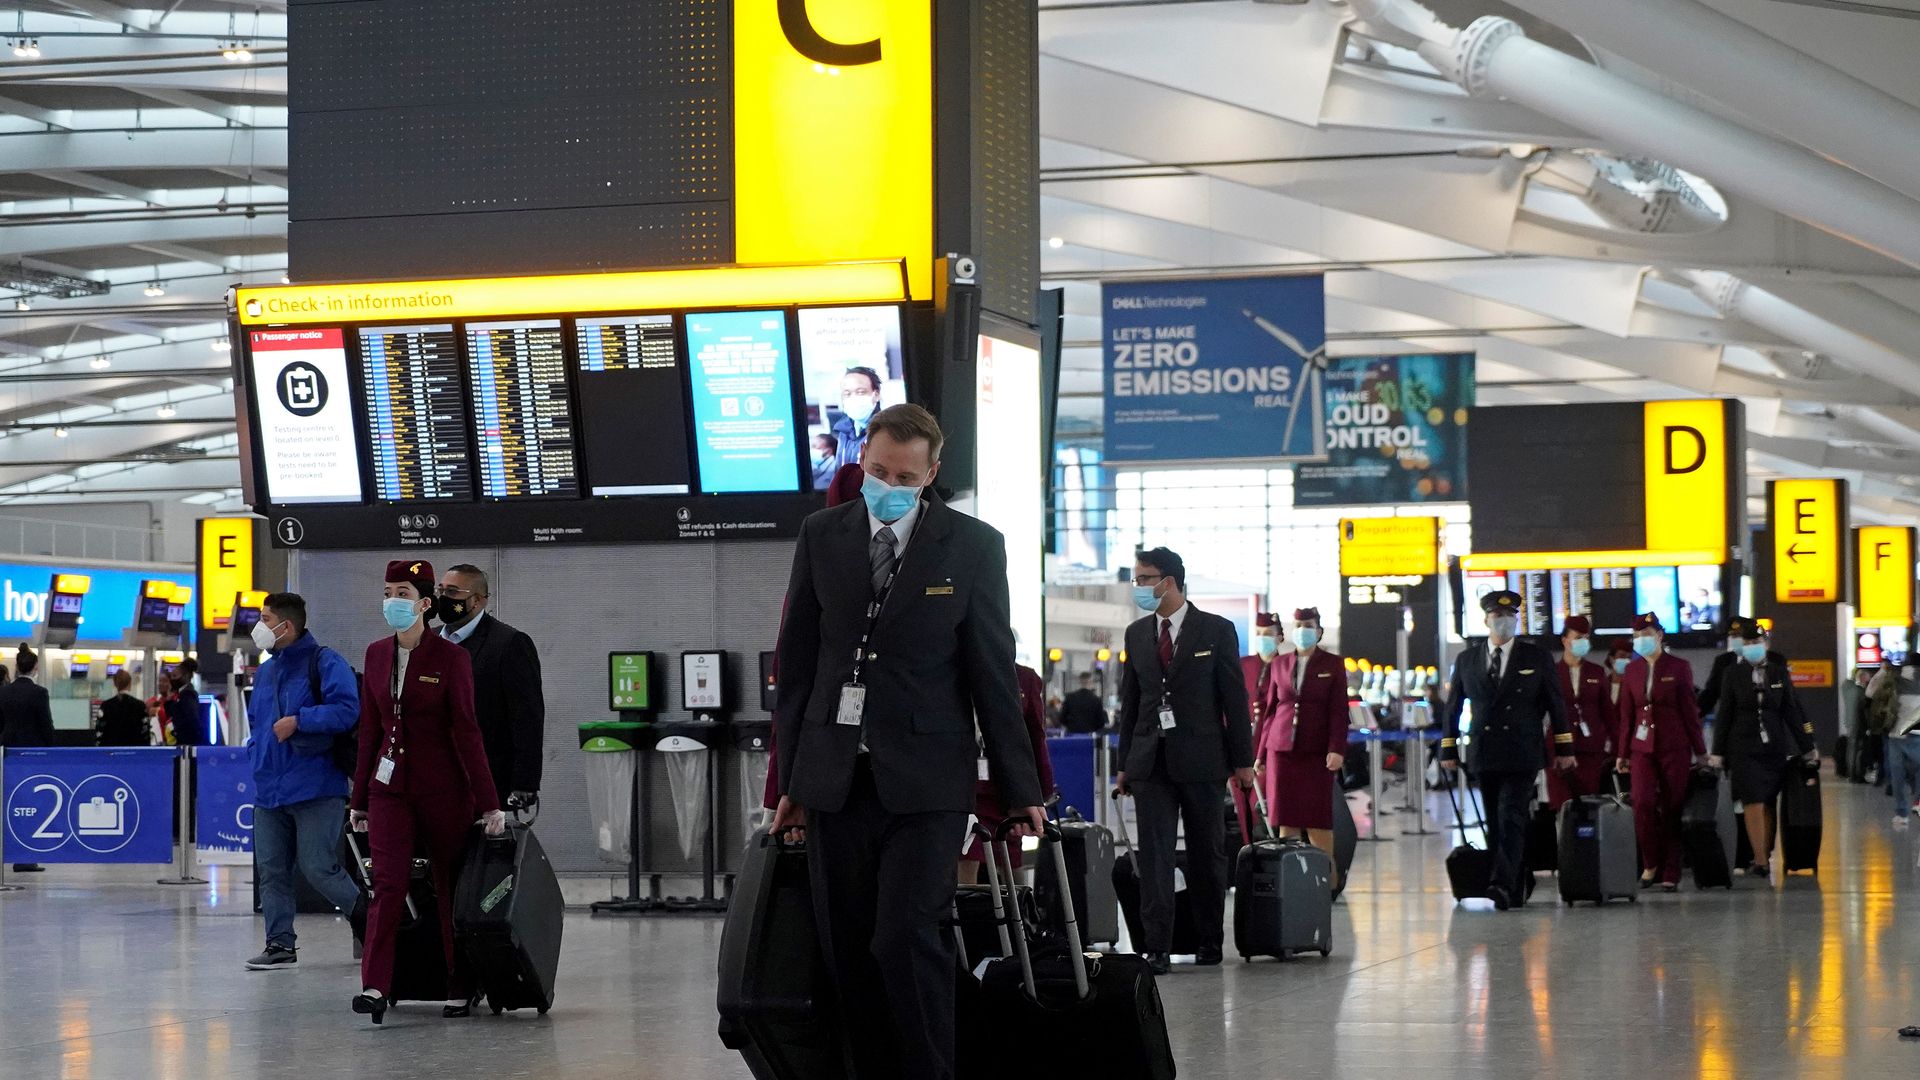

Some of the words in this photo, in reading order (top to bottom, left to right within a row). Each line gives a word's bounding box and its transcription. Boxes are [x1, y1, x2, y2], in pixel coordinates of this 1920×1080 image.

[268, 295, 344, 314] Check-in
[349, 291, 454, 310] information
[262, 332, 298, 342] Passenger
[299, 331, 323, 339] notice
[1113, 327, 1152, 341] LET'S
[1155, 325, 1196, 340] MAKE
[1113, 341, 1199, 369] ZERO
[1113, 366, 1291, 396] EMISSIONS
[1254, 394, 1291, 408] REAL
[1664, 425, 1707, 475] D
[1795, 498, 1816, 535] E
[219, 535, 237, 568] E
[1875, 542, 1891, 571] F
[13, 807, 38, 817] STEP
[31, 783, 64, 839] 2
